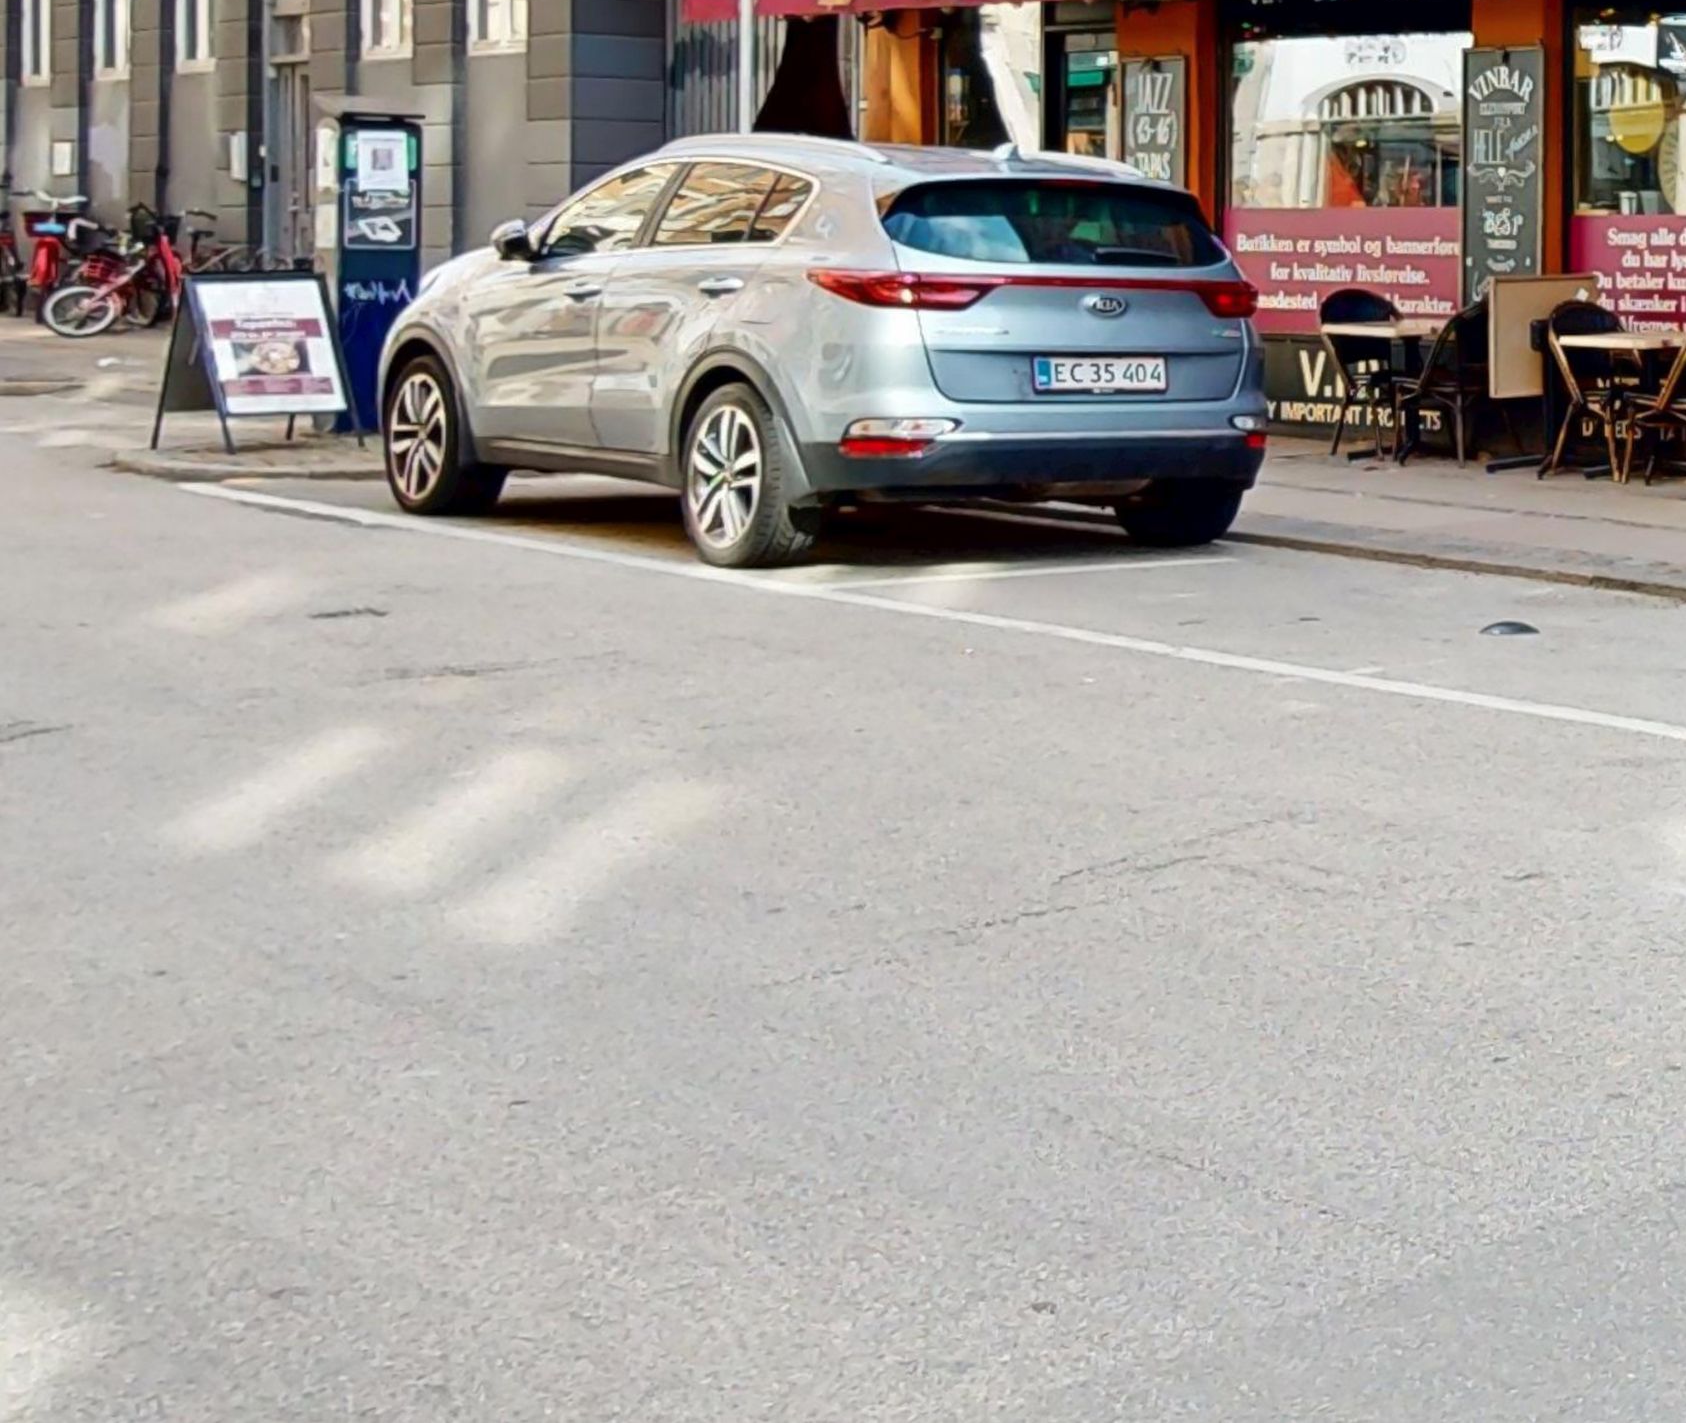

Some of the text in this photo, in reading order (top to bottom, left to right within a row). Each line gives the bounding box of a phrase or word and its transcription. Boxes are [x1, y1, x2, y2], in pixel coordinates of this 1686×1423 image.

[1134, 72, 1174, 115] JAZZ
[1467, 65, 1534, 103] VINBAR
[1236, 233, 1294, 254] Butikken
[1297, 238, 1310, 253] er
[1314, 235, 1361, 257] symbol
[1363, 240, 1382, 258] og
[1607, 227, 1647, 249] Smag
[1650, 227, 1676, 246] alle
[1621, 249, 1641, 268] du
[1643, 249, 1668, 269] har
[1270, 261, 1430, 285] for kvalitativ livsførelse.
[1615, 271, 1666, 290] betaler
[1094, 298, 1119, 311] KIA
[1617, 292, 1678, 313] skænker
[1053, 362, 1162, 384] EC 35 404
[1280, 400, 1363, 427] IMPORTANT
